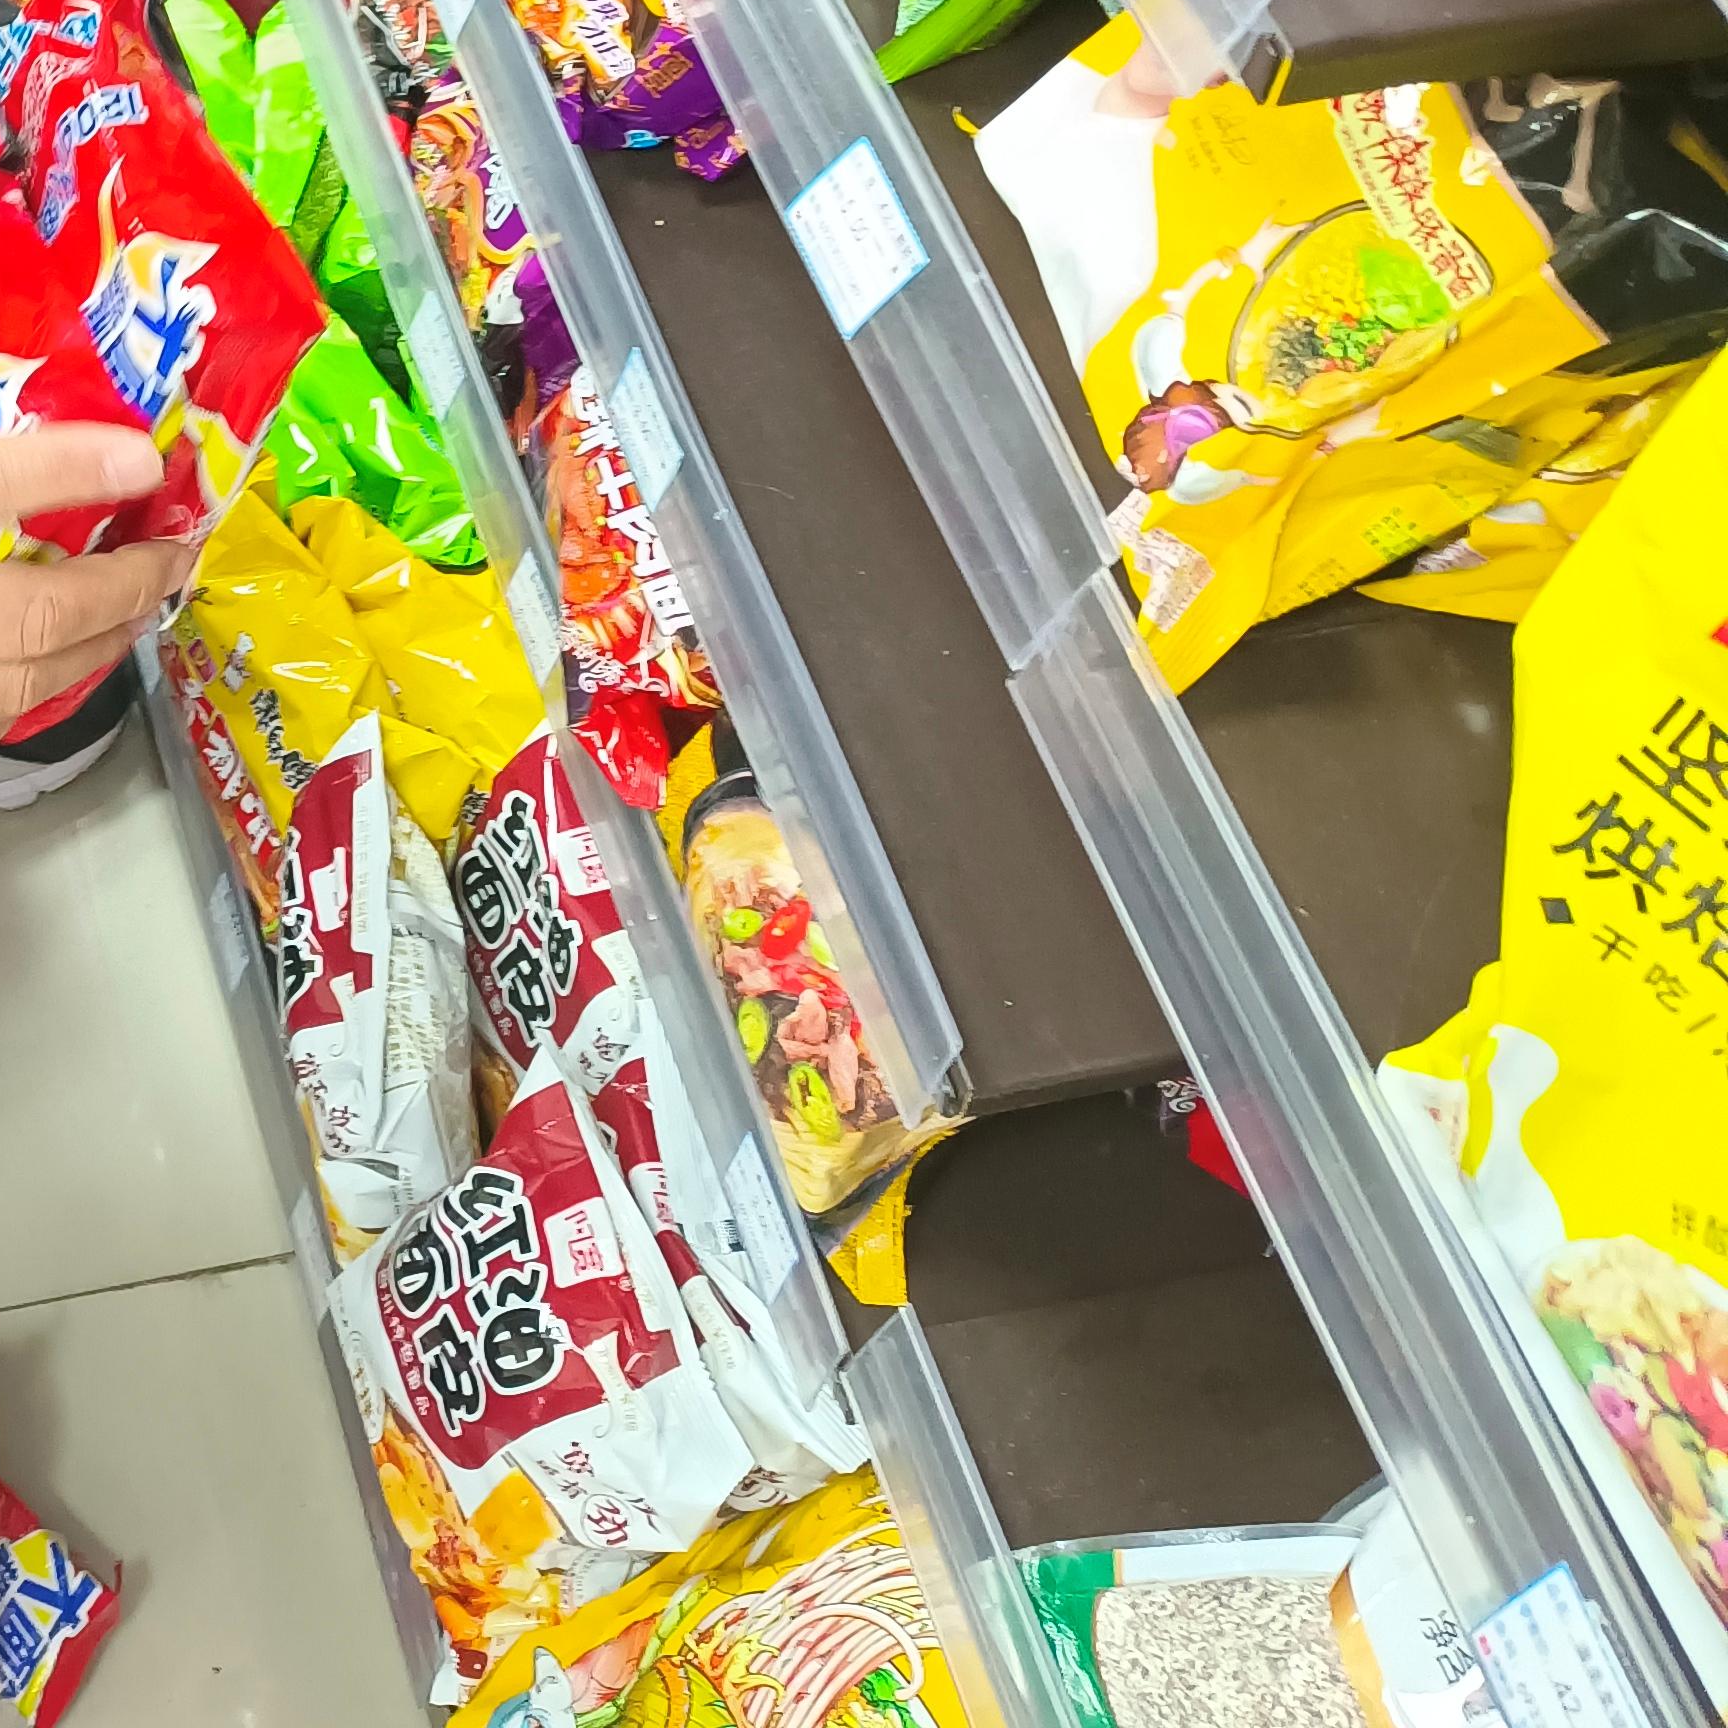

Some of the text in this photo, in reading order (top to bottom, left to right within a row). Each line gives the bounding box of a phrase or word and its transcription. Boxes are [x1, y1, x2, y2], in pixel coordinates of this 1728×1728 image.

[1618, 696, 1728, 833] 坚
[1592, 923, 1719, 1036] 干吃/
[390, 1198, 483, 1435] 面皮
[459, 1170, 566, 1392] 红油
